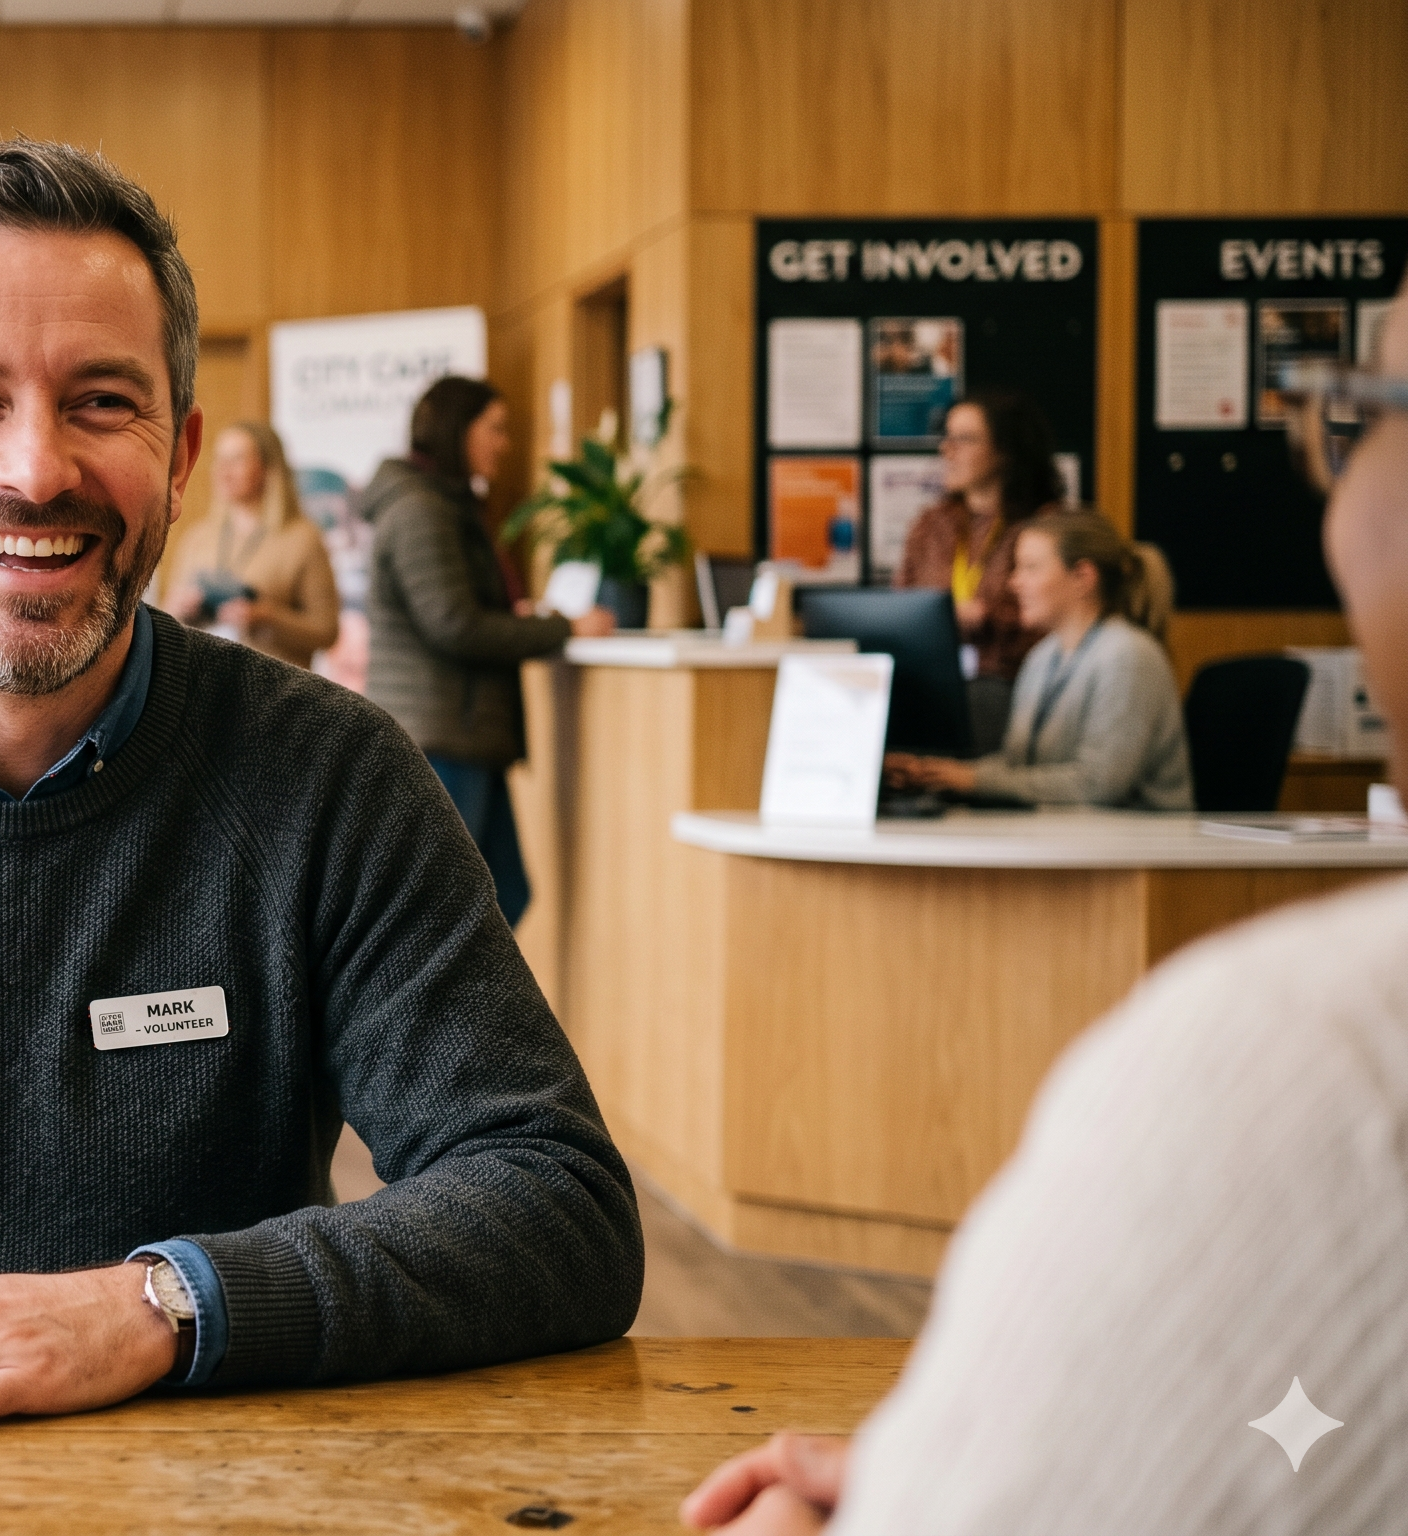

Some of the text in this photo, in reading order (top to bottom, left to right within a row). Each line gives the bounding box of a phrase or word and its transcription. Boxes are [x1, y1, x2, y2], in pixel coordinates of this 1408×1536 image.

[769, 239, 1082, 282] GET INVOLVED
[1220, 239, 1385, 280] EVENTS
[147, 1000, 195, 1018] MARK
[144, 1017, 213, 1034] VOLUNTEER
